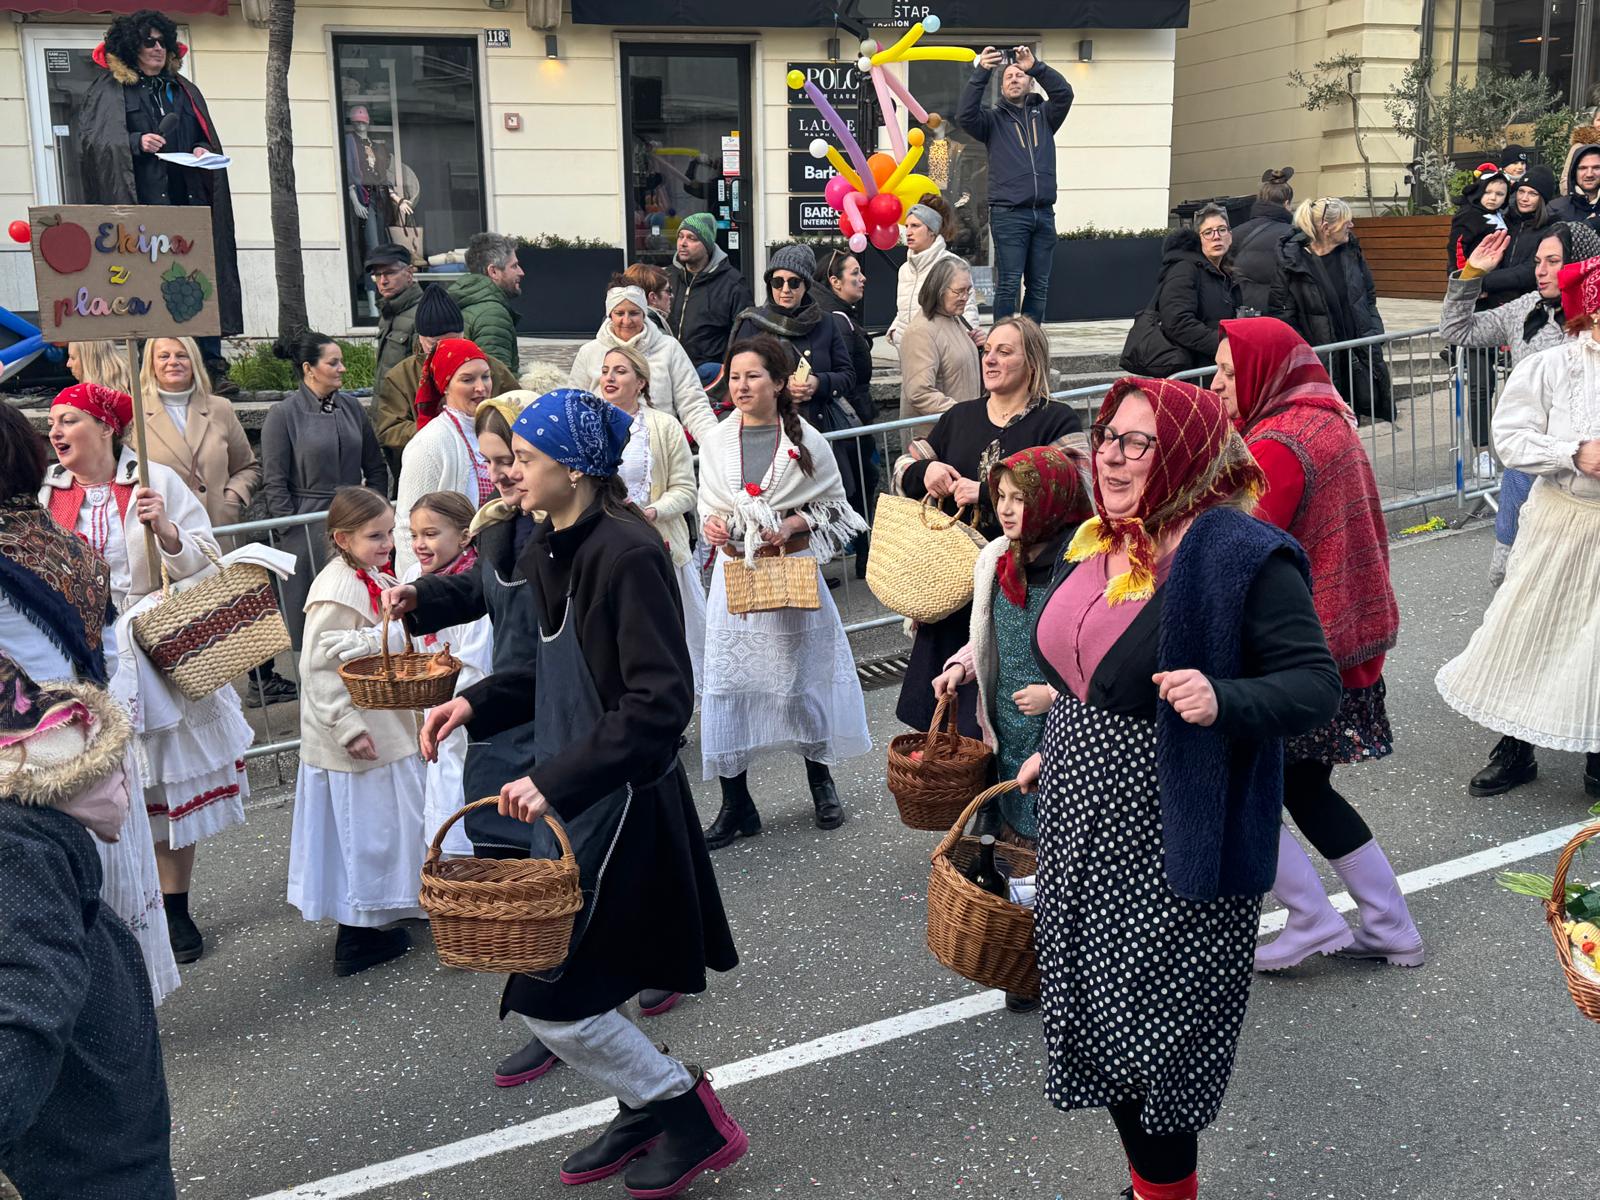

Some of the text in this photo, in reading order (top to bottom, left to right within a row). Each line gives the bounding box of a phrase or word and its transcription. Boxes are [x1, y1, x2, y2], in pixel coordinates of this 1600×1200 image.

[799, 119, 856, 132] LAUE
[804, 165, 837, 179] Barb
[95, 222, 194, 263] Ekipa
[54, 286, 152, 327] placa
